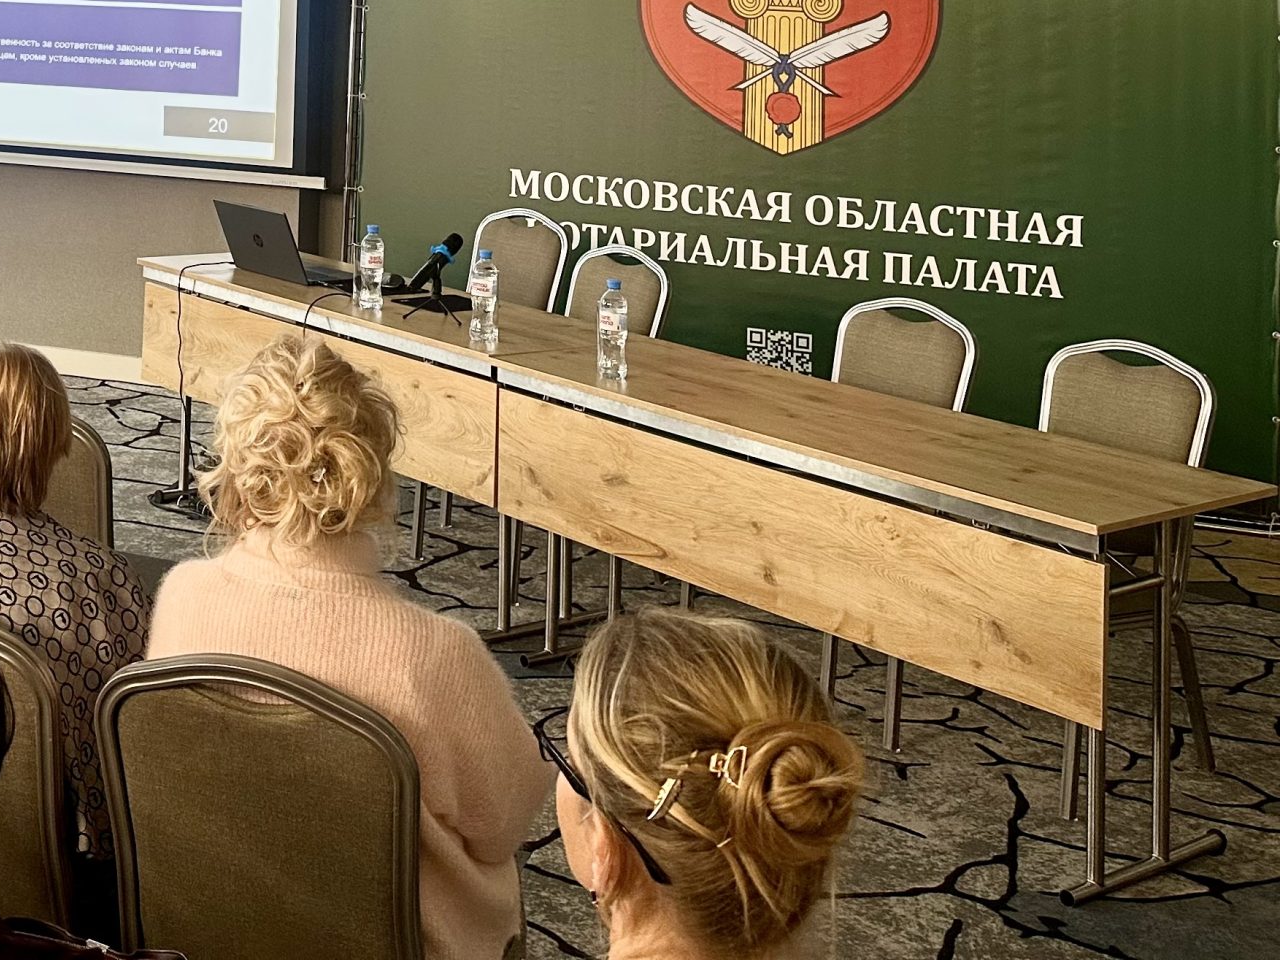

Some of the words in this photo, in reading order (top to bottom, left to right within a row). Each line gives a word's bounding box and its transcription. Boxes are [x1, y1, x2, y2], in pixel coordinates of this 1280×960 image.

[41, 39, 52, 48] за
[53, 40, 114, 51] соответствие
[115, 43, 154, 53] законам
[154, 45, 161, 54] и
[162, 45, 191, 55] актам
[192, 45, 222, 57] Банка
[19, 52, 46, 64] кроме
[47, 53, 117, 68] установленных
[118, 57, 156, 67] законом
[208, 117, 228, 133] 20
[509, 168, 792, 223] МОСКОВСКАЯ
[805, 194, 1084, 247] ОБЛАСТНАЯ
[526, 218, 869, 281] ОТАРИАЛЬНАЯ
[882, 251, 1064, 299] ПАЛАТА
